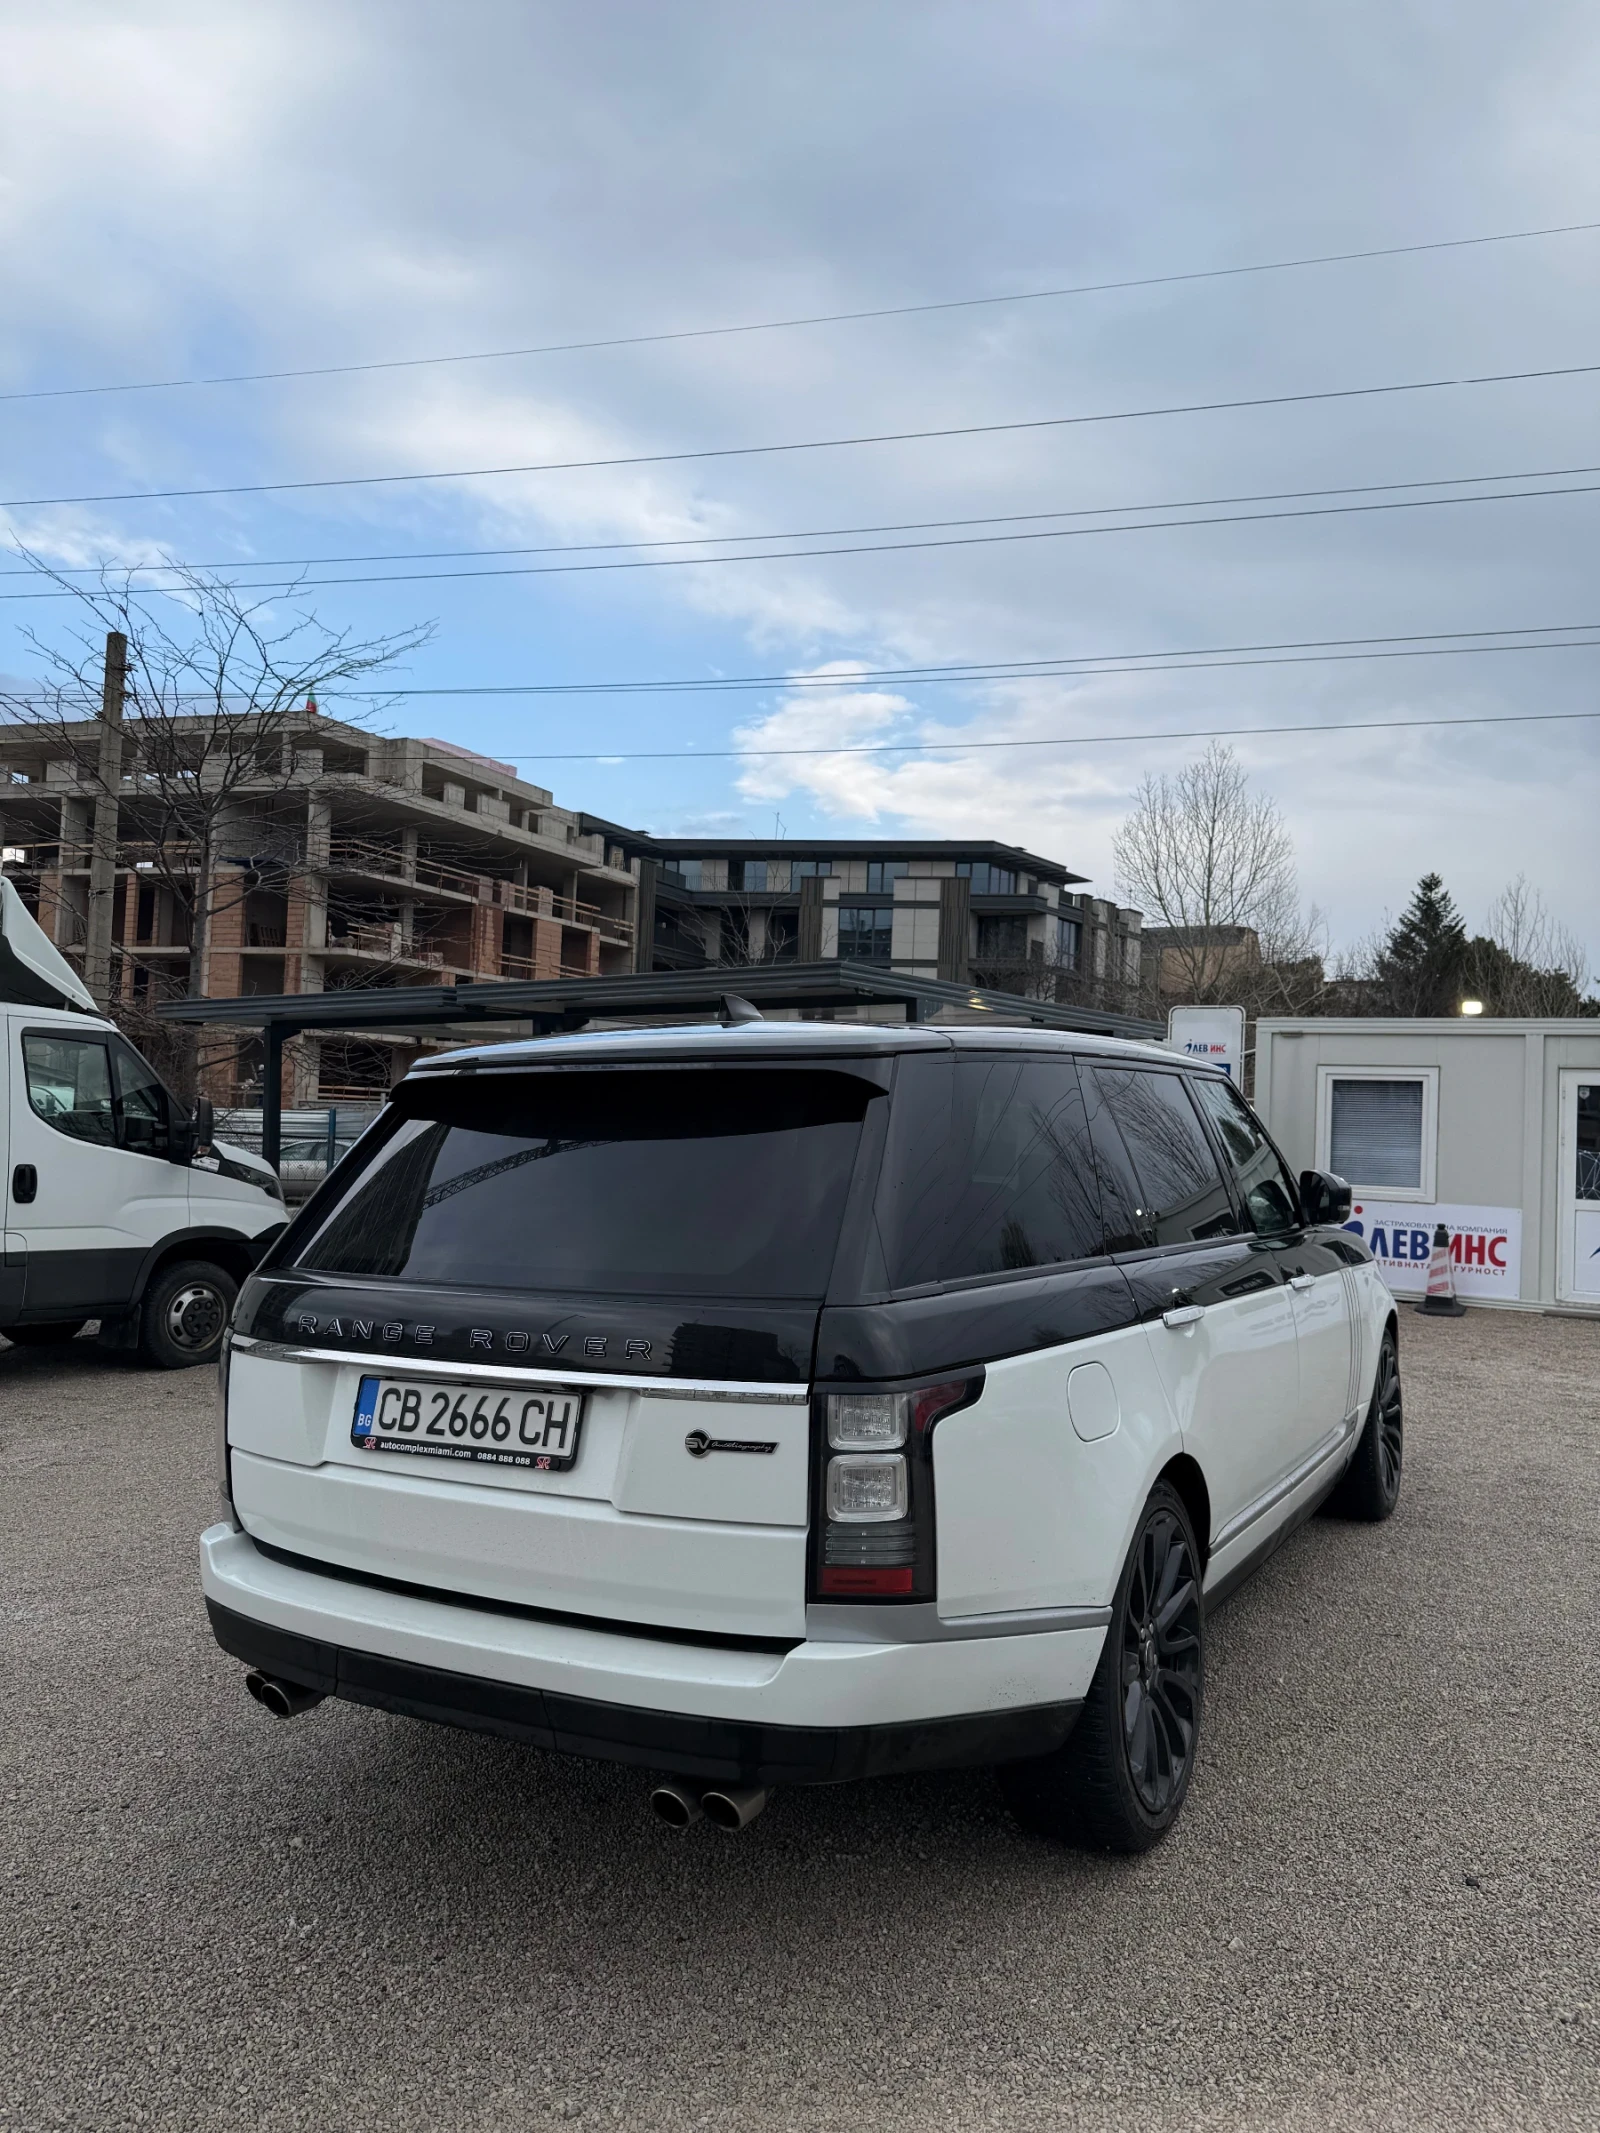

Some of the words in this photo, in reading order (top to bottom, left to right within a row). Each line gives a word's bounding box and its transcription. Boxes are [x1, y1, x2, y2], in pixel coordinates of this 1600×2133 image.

[1192, 1044, 1208, 1053] ЛЕВ
[1210, 1044, 1226, 1053] ИНС
[1457, 1225, 1508, 1235] КОМПАНИЯ
[1369, 1227, 1430, 1261] ЛЕВ
[1453, 1266, 1507, 1276] ГУРНОСТ
[298, 1314, 436, 1345] RANGE
[469, 1328, 652, 1361] ROVER
[357, 1413, 373, 1427] BG
[378, 1387, 422, 1433] CB
[425, 1391, 511, 1442] 2666
[519, 1399, 571, 1449] CH
[685, 1437, 710, 1449] SV
[380, 1440, 472, 1459] autocomplexmiami.com
[477, 1451, 497, 1462] 0884
